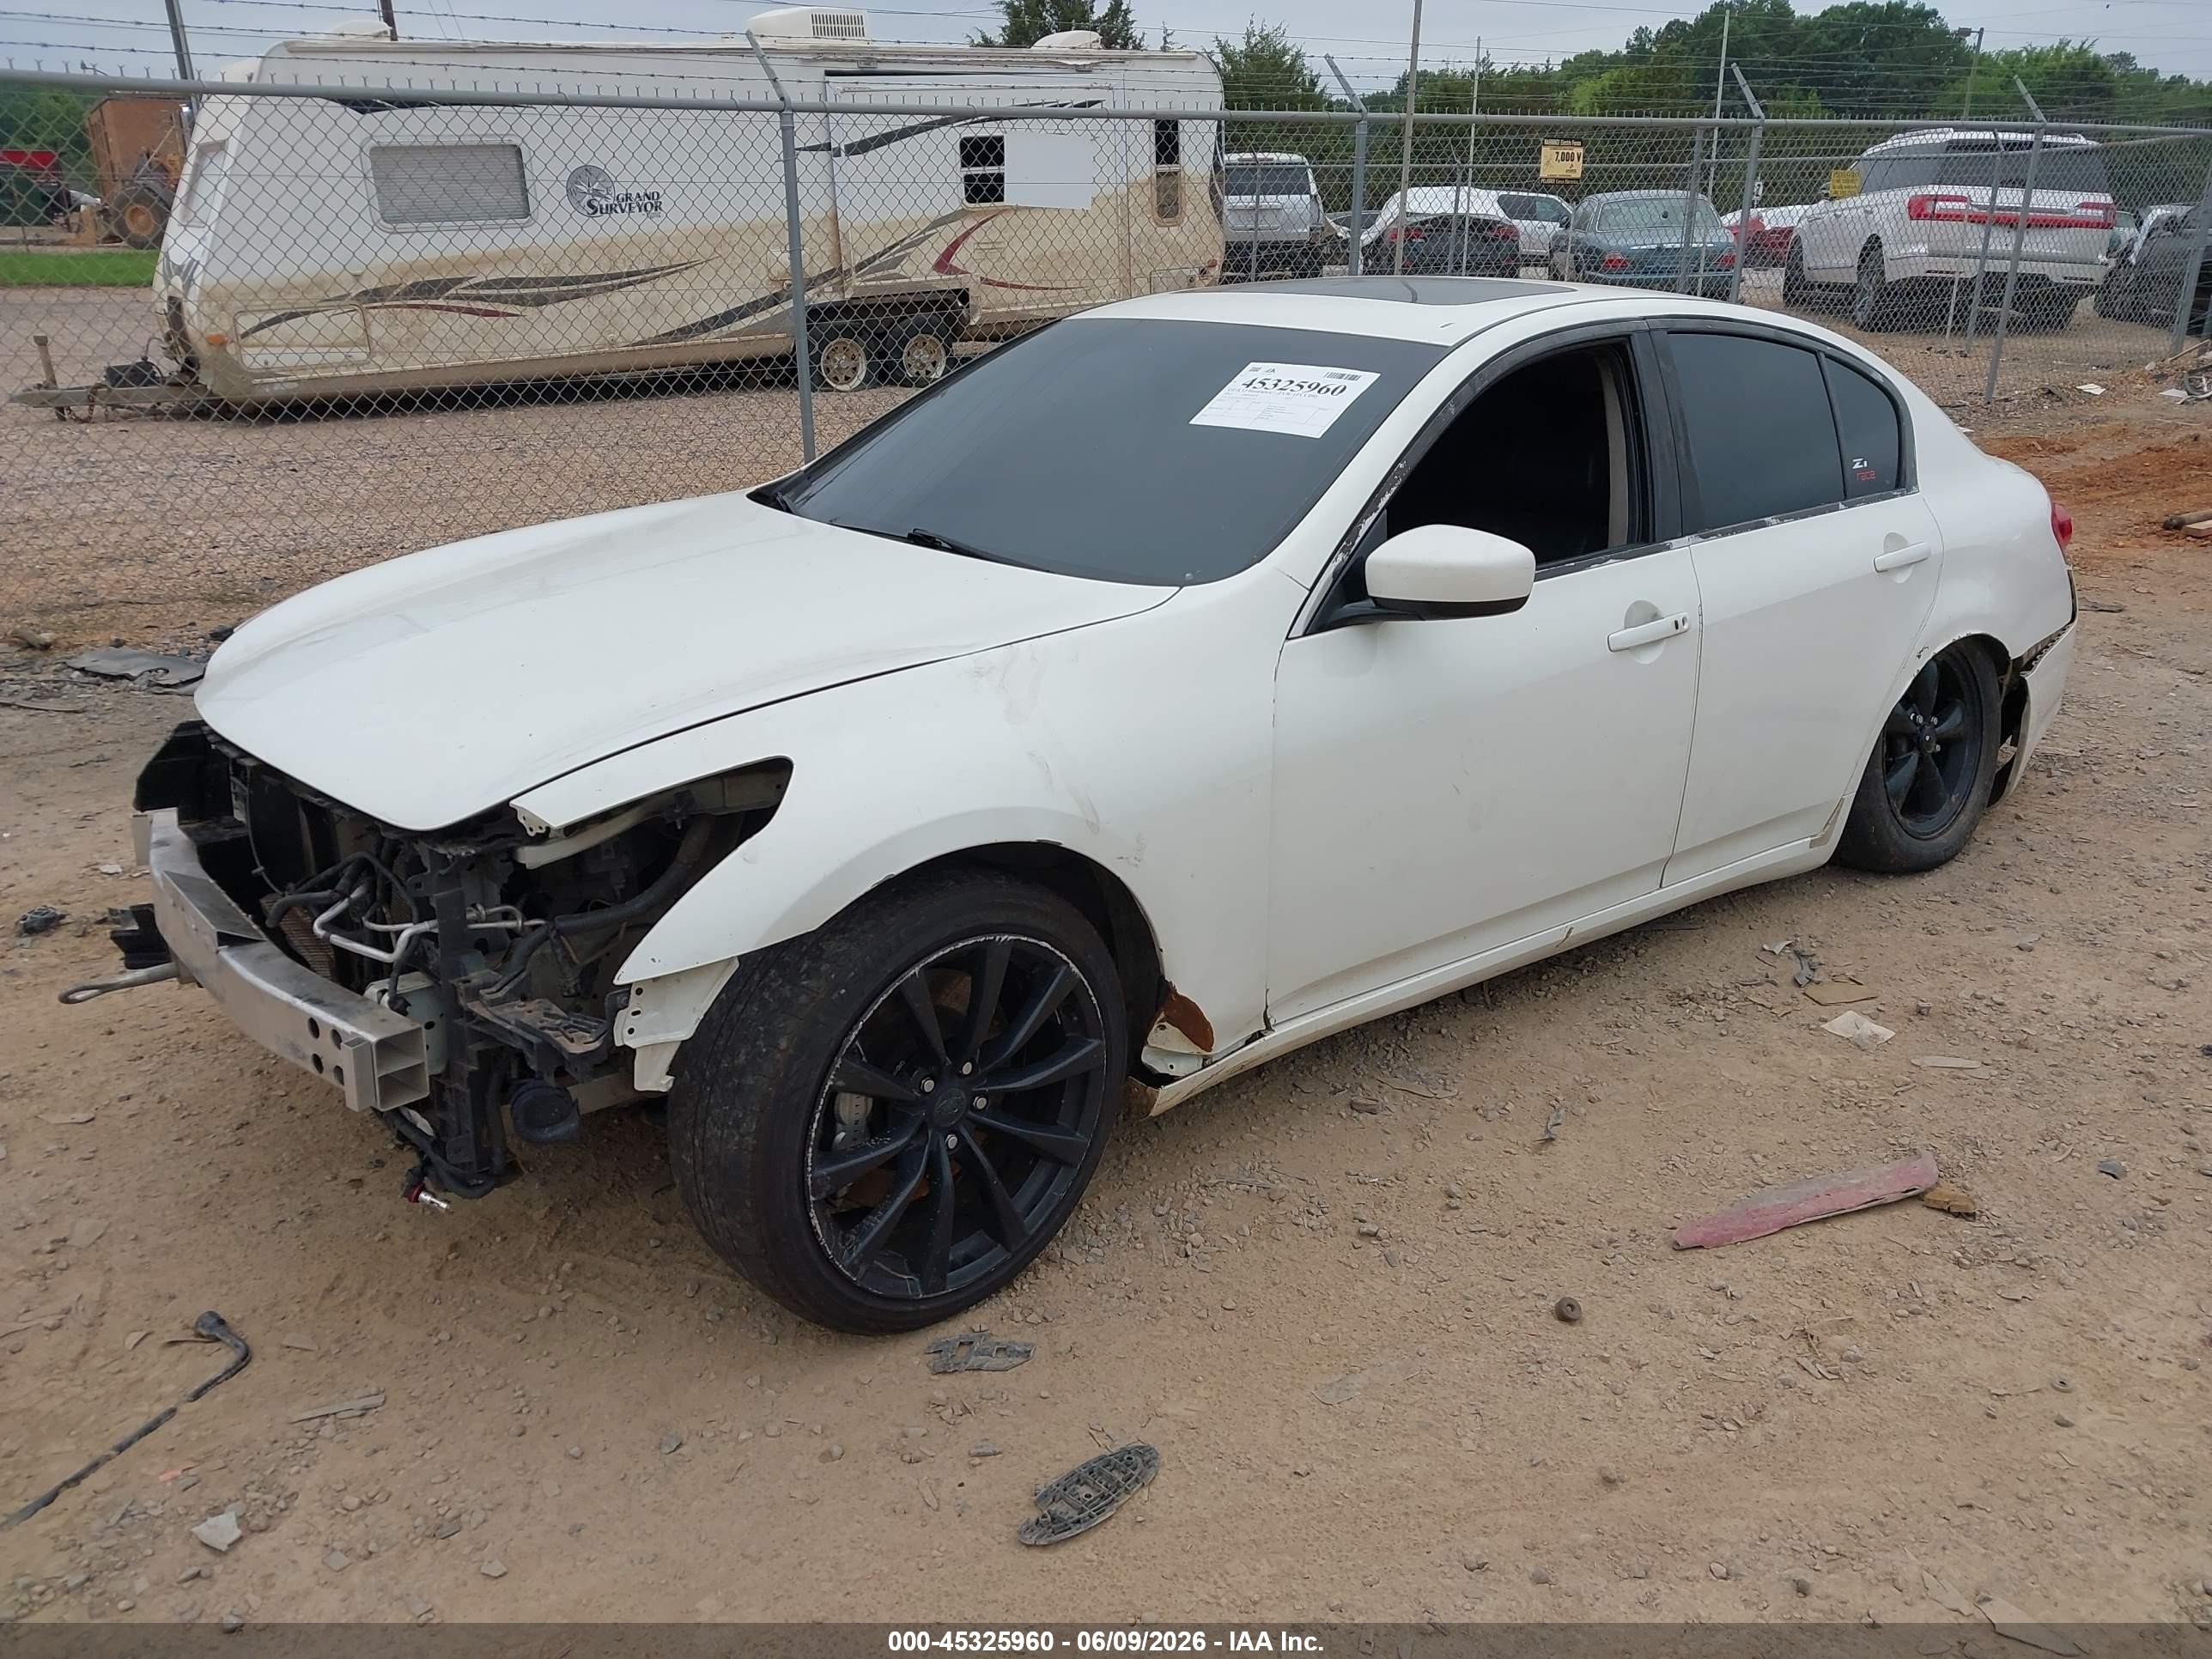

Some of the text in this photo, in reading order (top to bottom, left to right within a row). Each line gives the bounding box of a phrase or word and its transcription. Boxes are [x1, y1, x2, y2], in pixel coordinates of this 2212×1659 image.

[1555, 151, 1582, 163] 7,000 V
[616, 191, 661, 203] GRAND
[586, 198, 664, 216] SURVEYOR
[1241, 376, 1348, 397] 45325960
